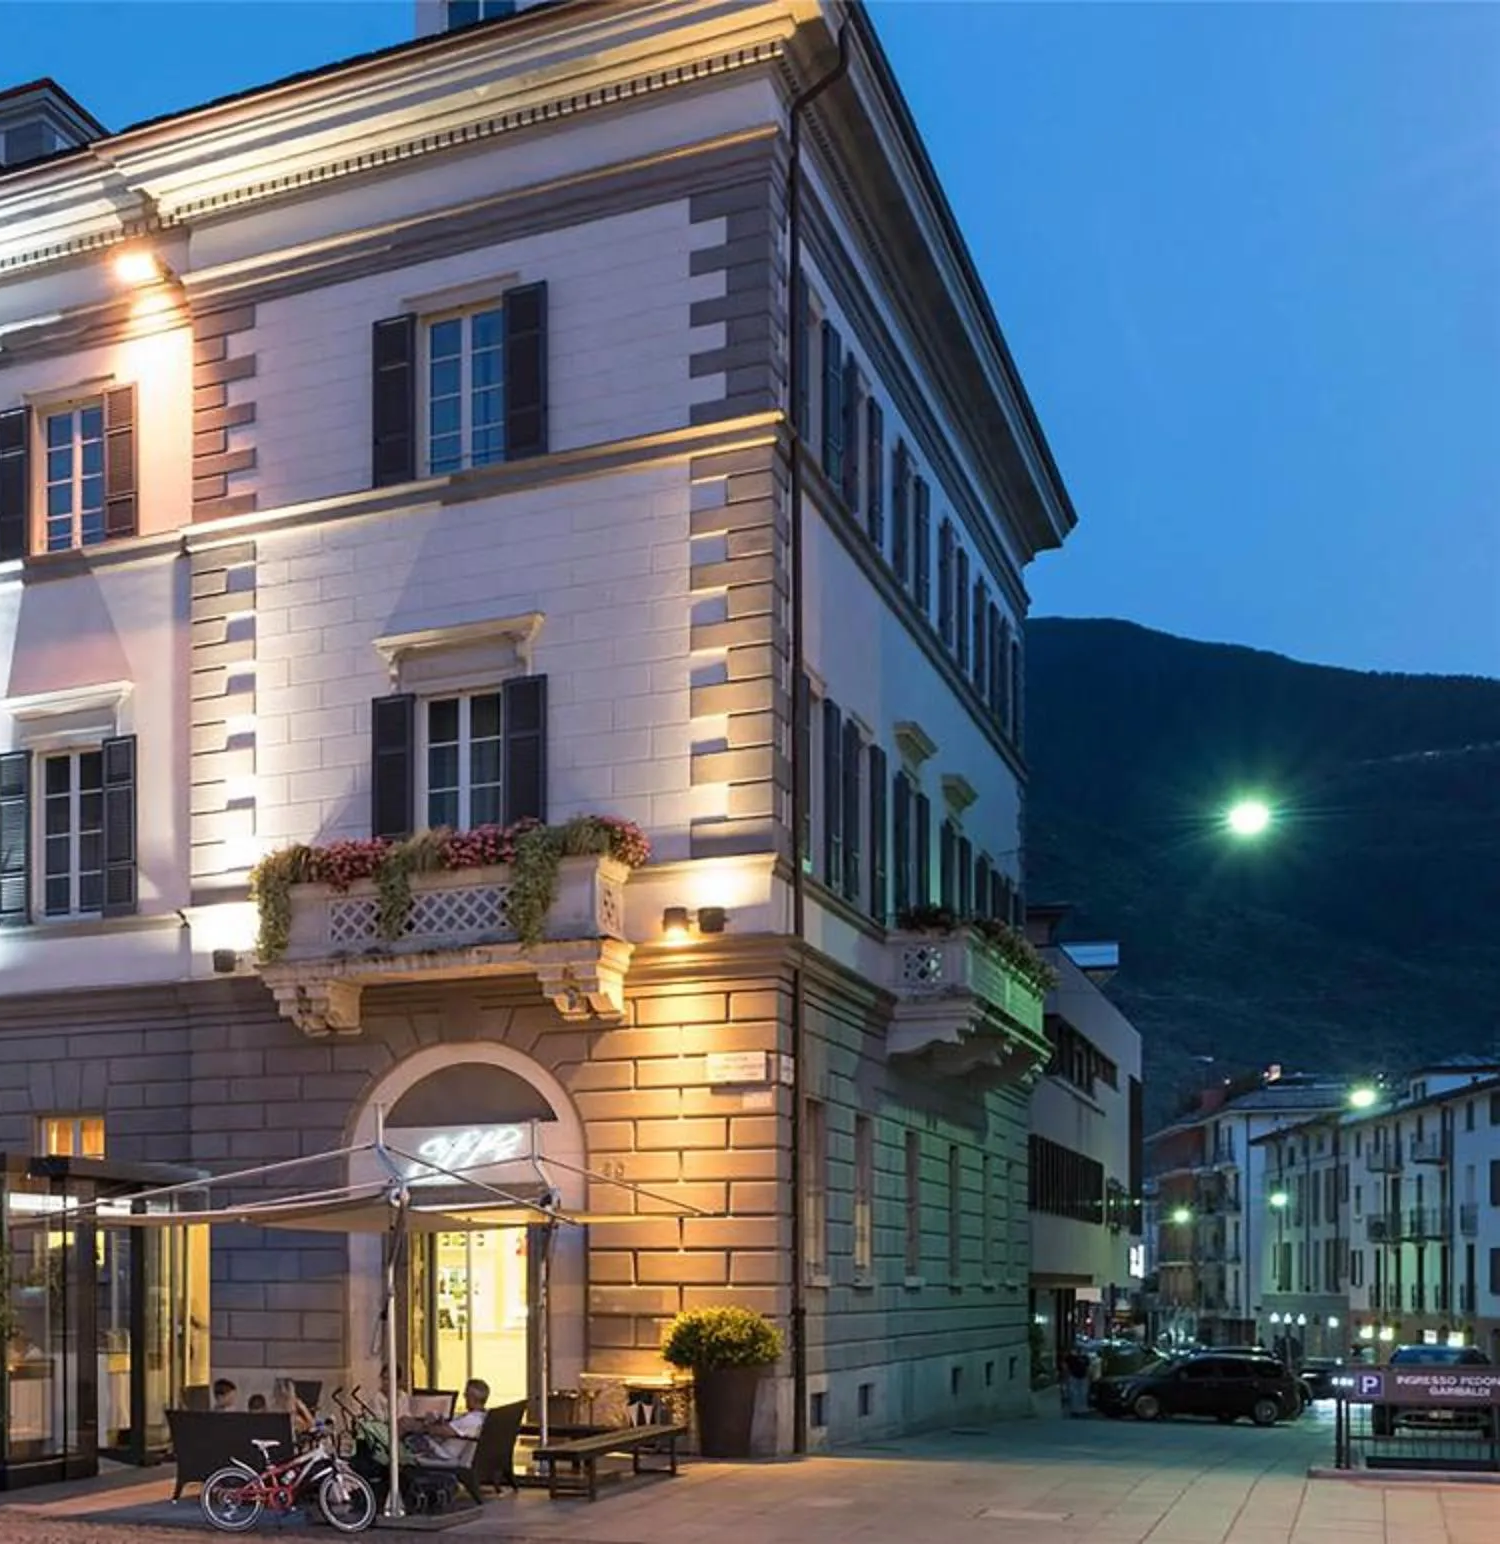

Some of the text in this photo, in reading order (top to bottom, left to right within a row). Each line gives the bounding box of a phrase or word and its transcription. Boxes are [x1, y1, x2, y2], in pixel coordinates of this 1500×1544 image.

[1361, 1375, 1379, 1394] P
[1395, 1375, 1457, 1386] INGRESSO
[1428, 1386, 1491, 1397] GARIBALDI
